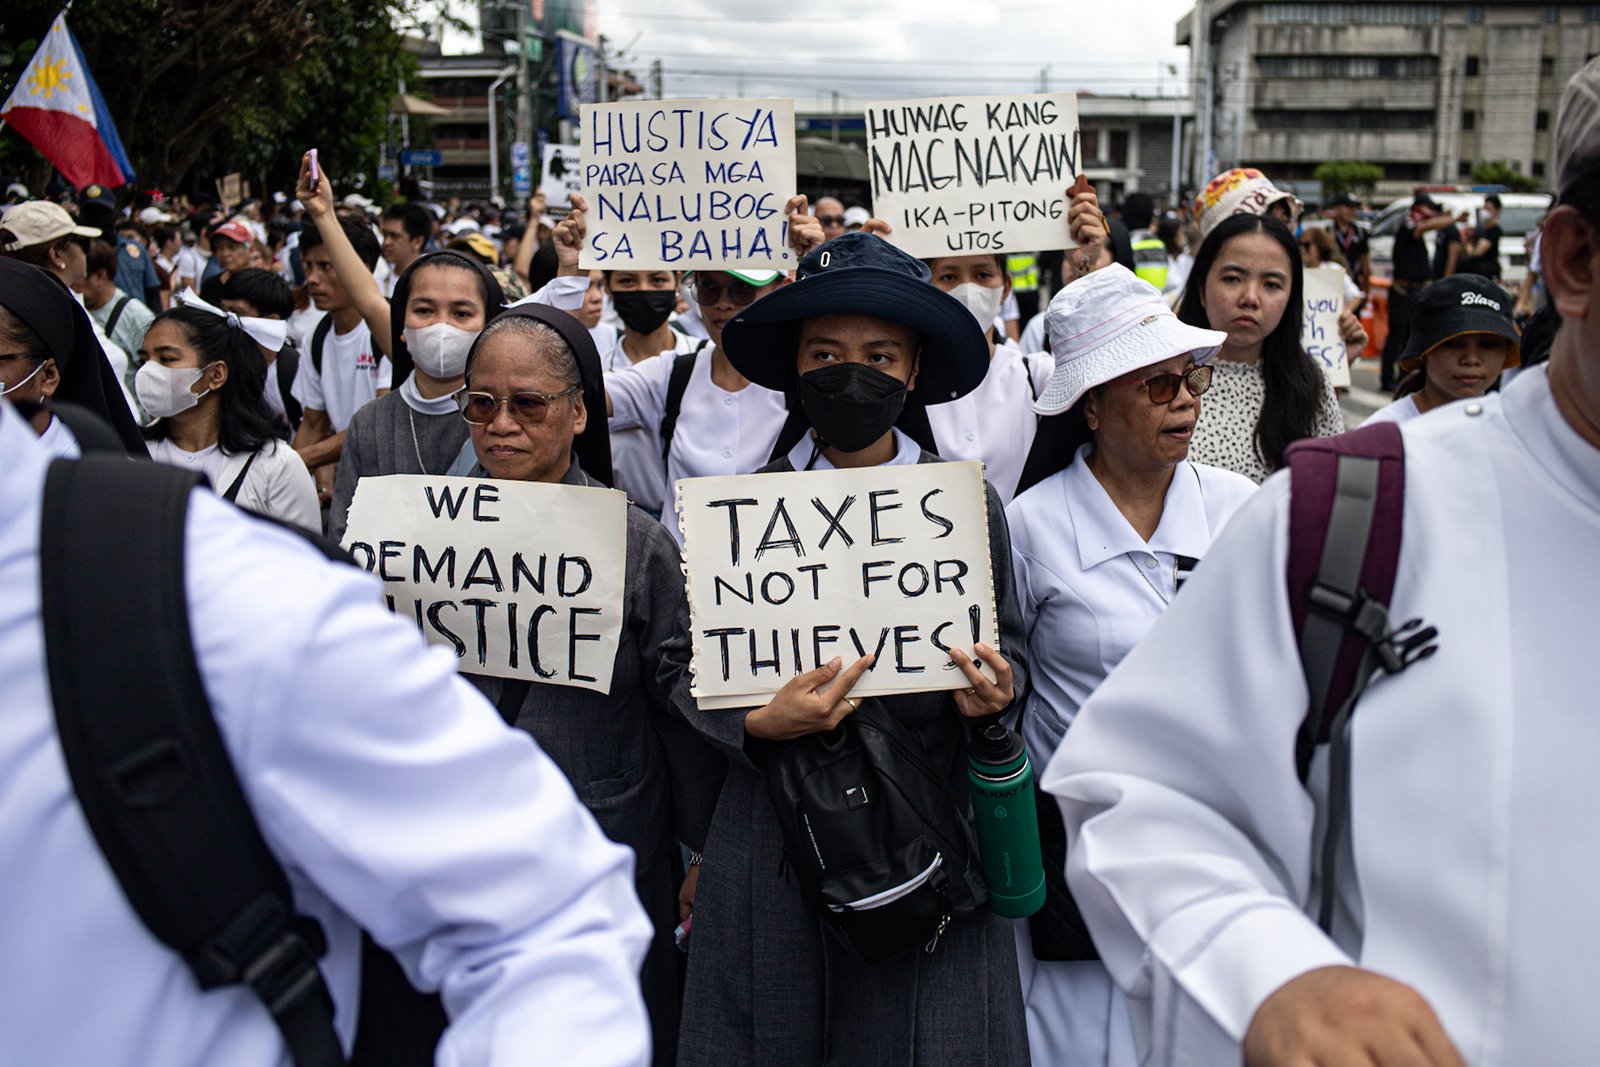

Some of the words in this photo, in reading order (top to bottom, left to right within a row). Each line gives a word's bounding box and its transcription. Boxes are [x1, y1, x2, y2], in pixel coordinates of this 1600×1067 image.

[593, 108, 778, 156] HUSTISYA
[869, 103, 968, 139] HUWAG
[986, 101, 1058, 132] KANG
[705, 160, 764, 184] MGA
[872, 126, 1080, 201] MAGNAKAW
[598, 190, 778, 222] NALUBOG
[904, 199, 1063, 229] IKA-PITONG
[592, 232, 634, 261] SA
[659, 221, 788, 262] BAHA!
[947, 231, 1004, 251] UTOS
[424, 484, 501, 522] WE
[706, 488, 954, 567] TAXES
[714, 563, 828, 605] NOT
[862, 559, 969, 599] FOR
[702, 604, 981, 681] THIEVES!
